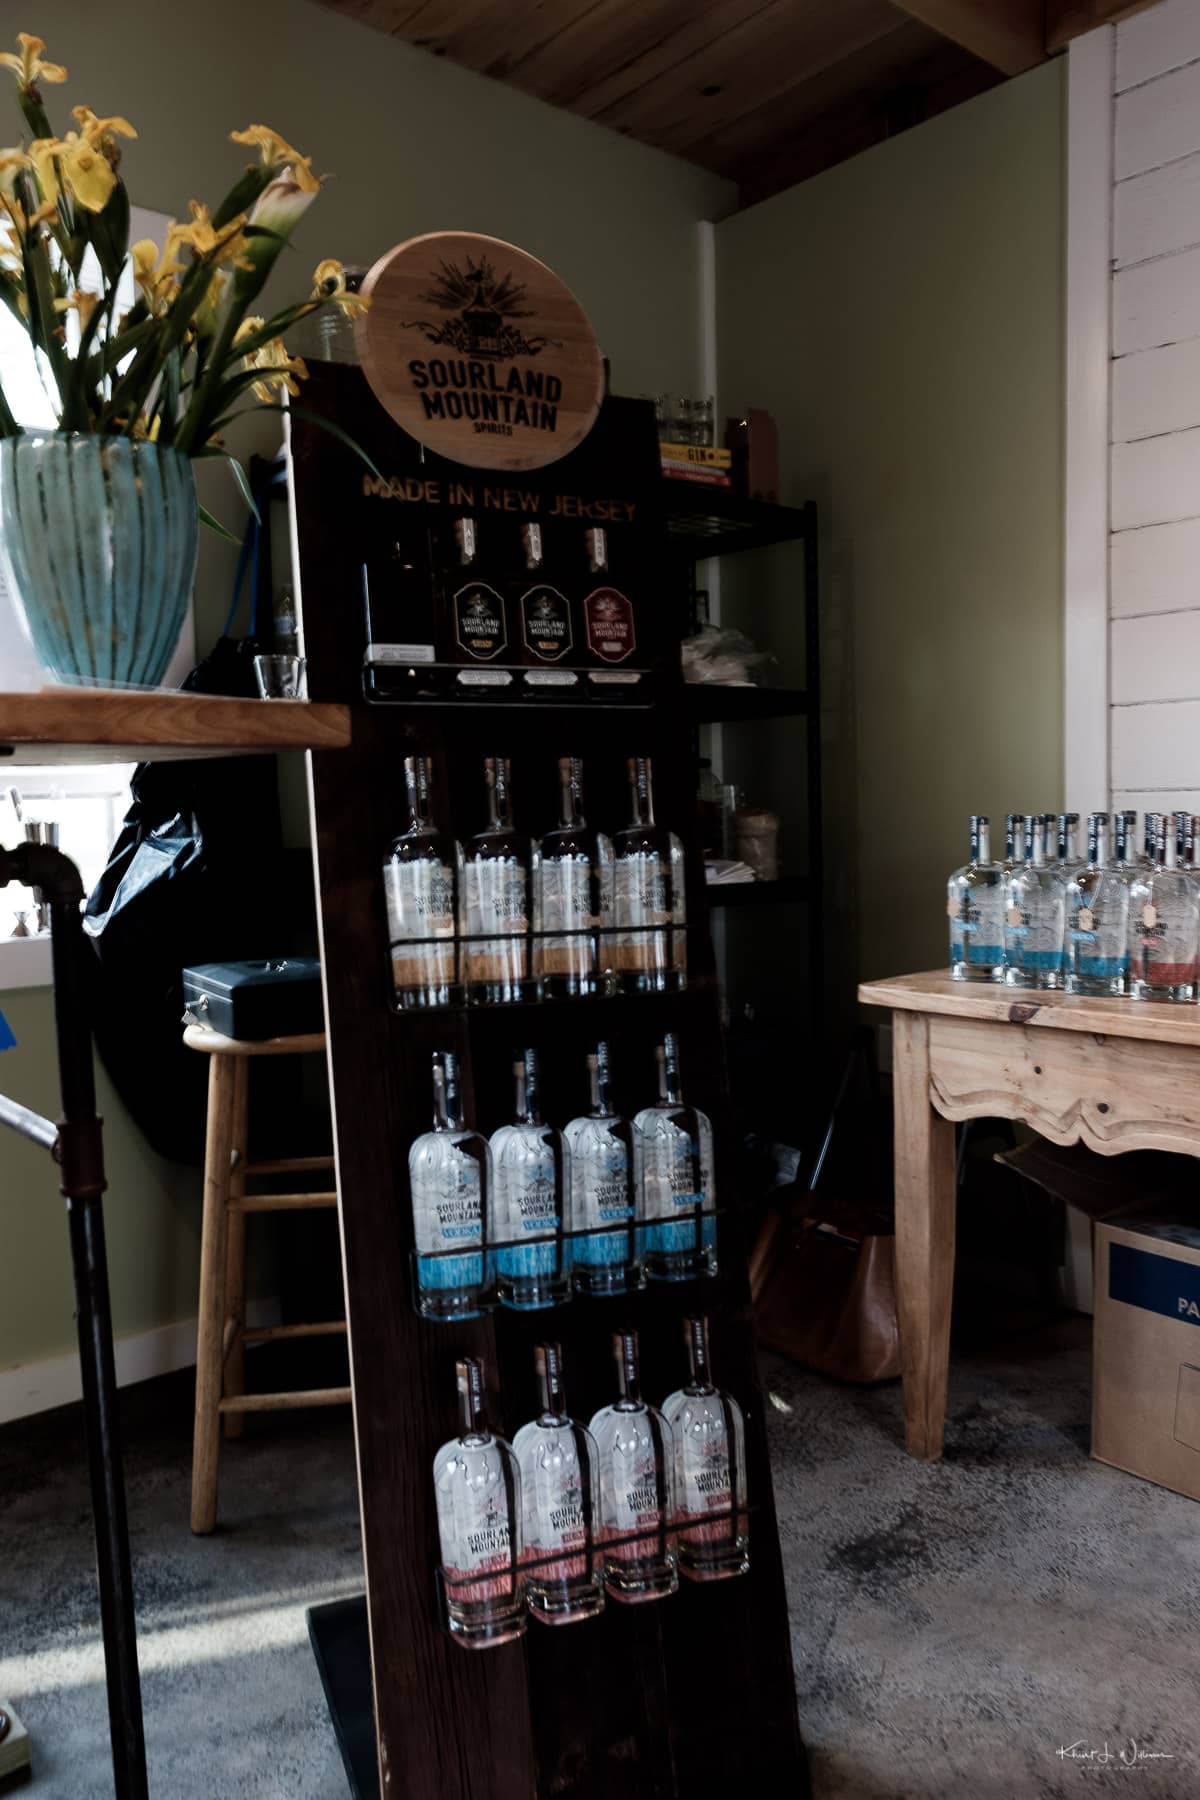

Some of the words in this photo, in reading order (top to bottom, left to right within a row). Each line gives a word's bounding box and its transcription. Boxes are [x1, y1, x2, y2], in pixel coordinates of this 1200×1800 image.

[409, 359, 561, 402] SOURLAND
[420, 391, 557, 432] MOUNTAIN
[473, 421, 513, 437] SPIRITS
[361, 472, 440, 504] MADE
[450, 482, 475, 507] IN
[484, 486, 542, 514] NEW
[549, 495, 637, 524] JERSEY
